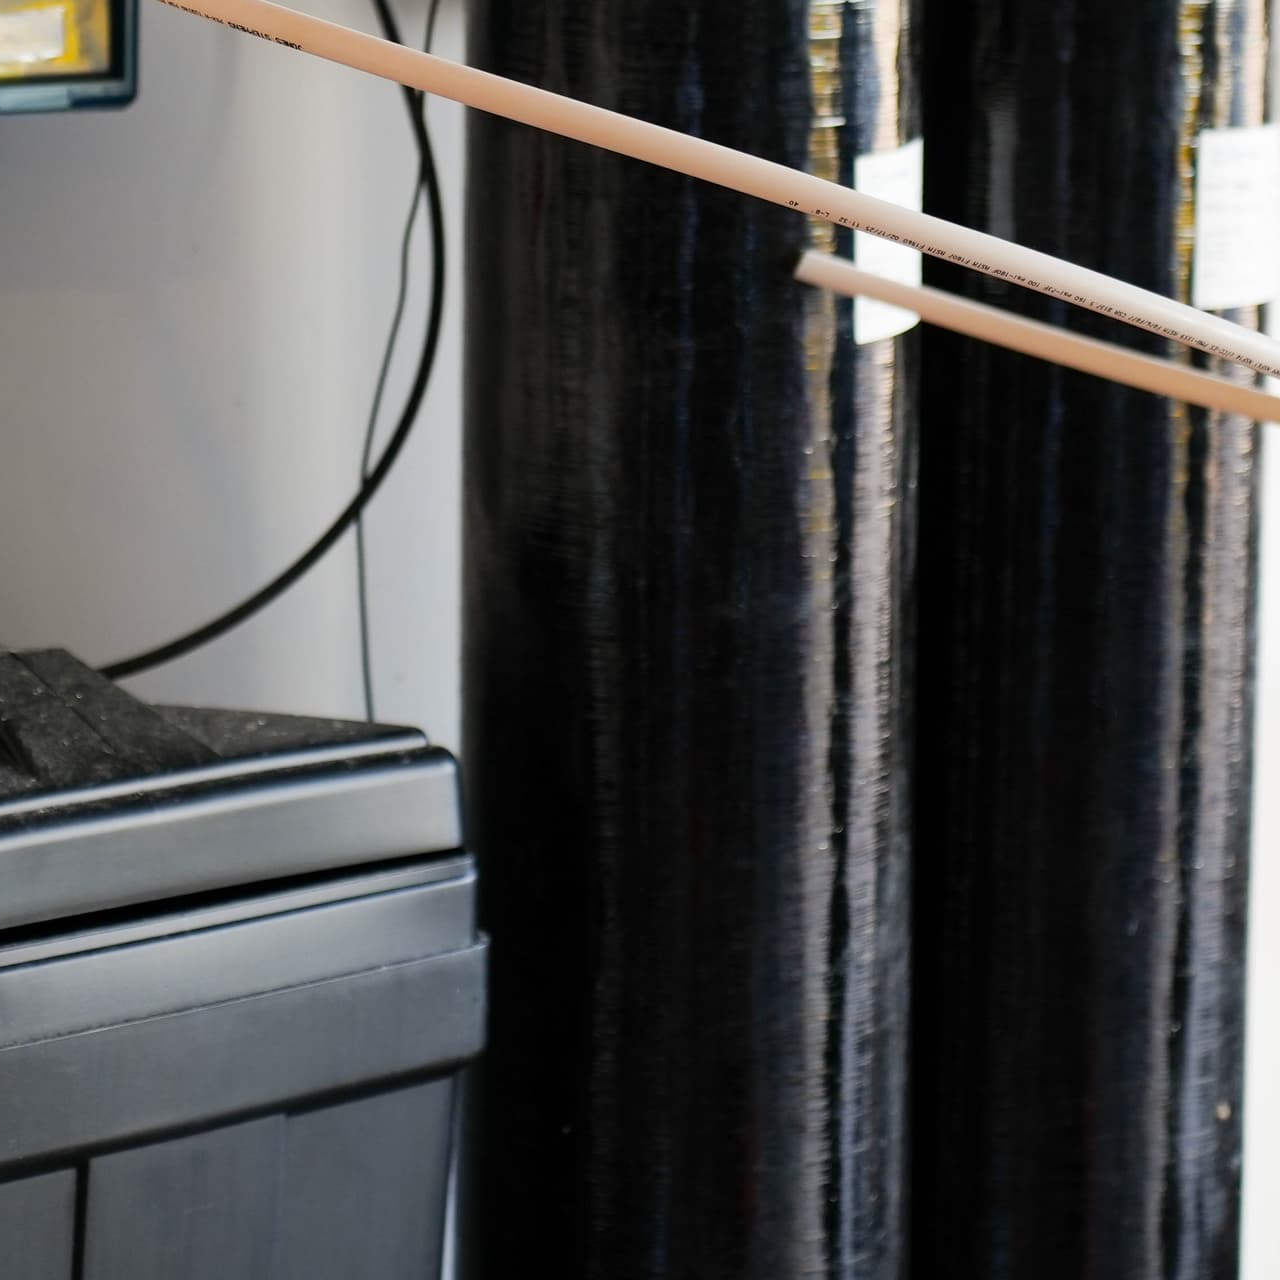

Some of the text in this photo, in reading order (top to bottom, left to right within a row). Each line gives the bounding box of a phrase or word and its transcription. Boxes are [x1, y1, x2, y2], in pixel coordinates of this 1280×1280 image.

[864, 225, 900, 241] 02/17/25
[927, 245, 945, 256] ASTM
[972, 260, 989, 271] ASTM
